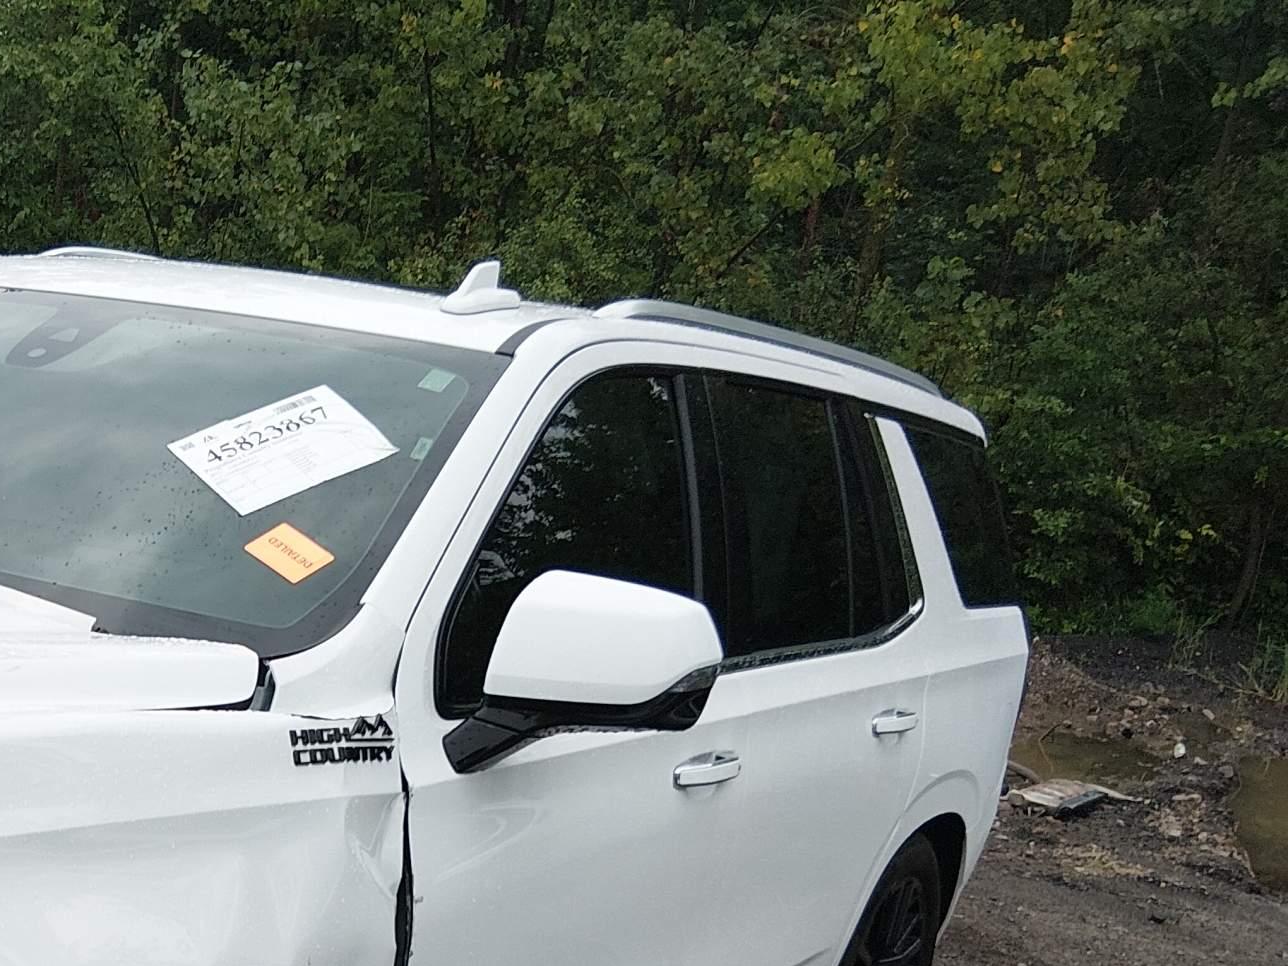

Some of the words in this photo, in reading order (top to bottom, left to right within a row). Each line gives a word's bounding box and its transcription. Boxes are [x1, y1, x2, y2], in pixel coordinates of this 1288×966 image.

[206, 406, 328, 463] 45823867
[268, 537, 314, 569] DETAILED
[289, 727, 352, 747] HIGH
[292, 745, 396, 767] COUNTRY
